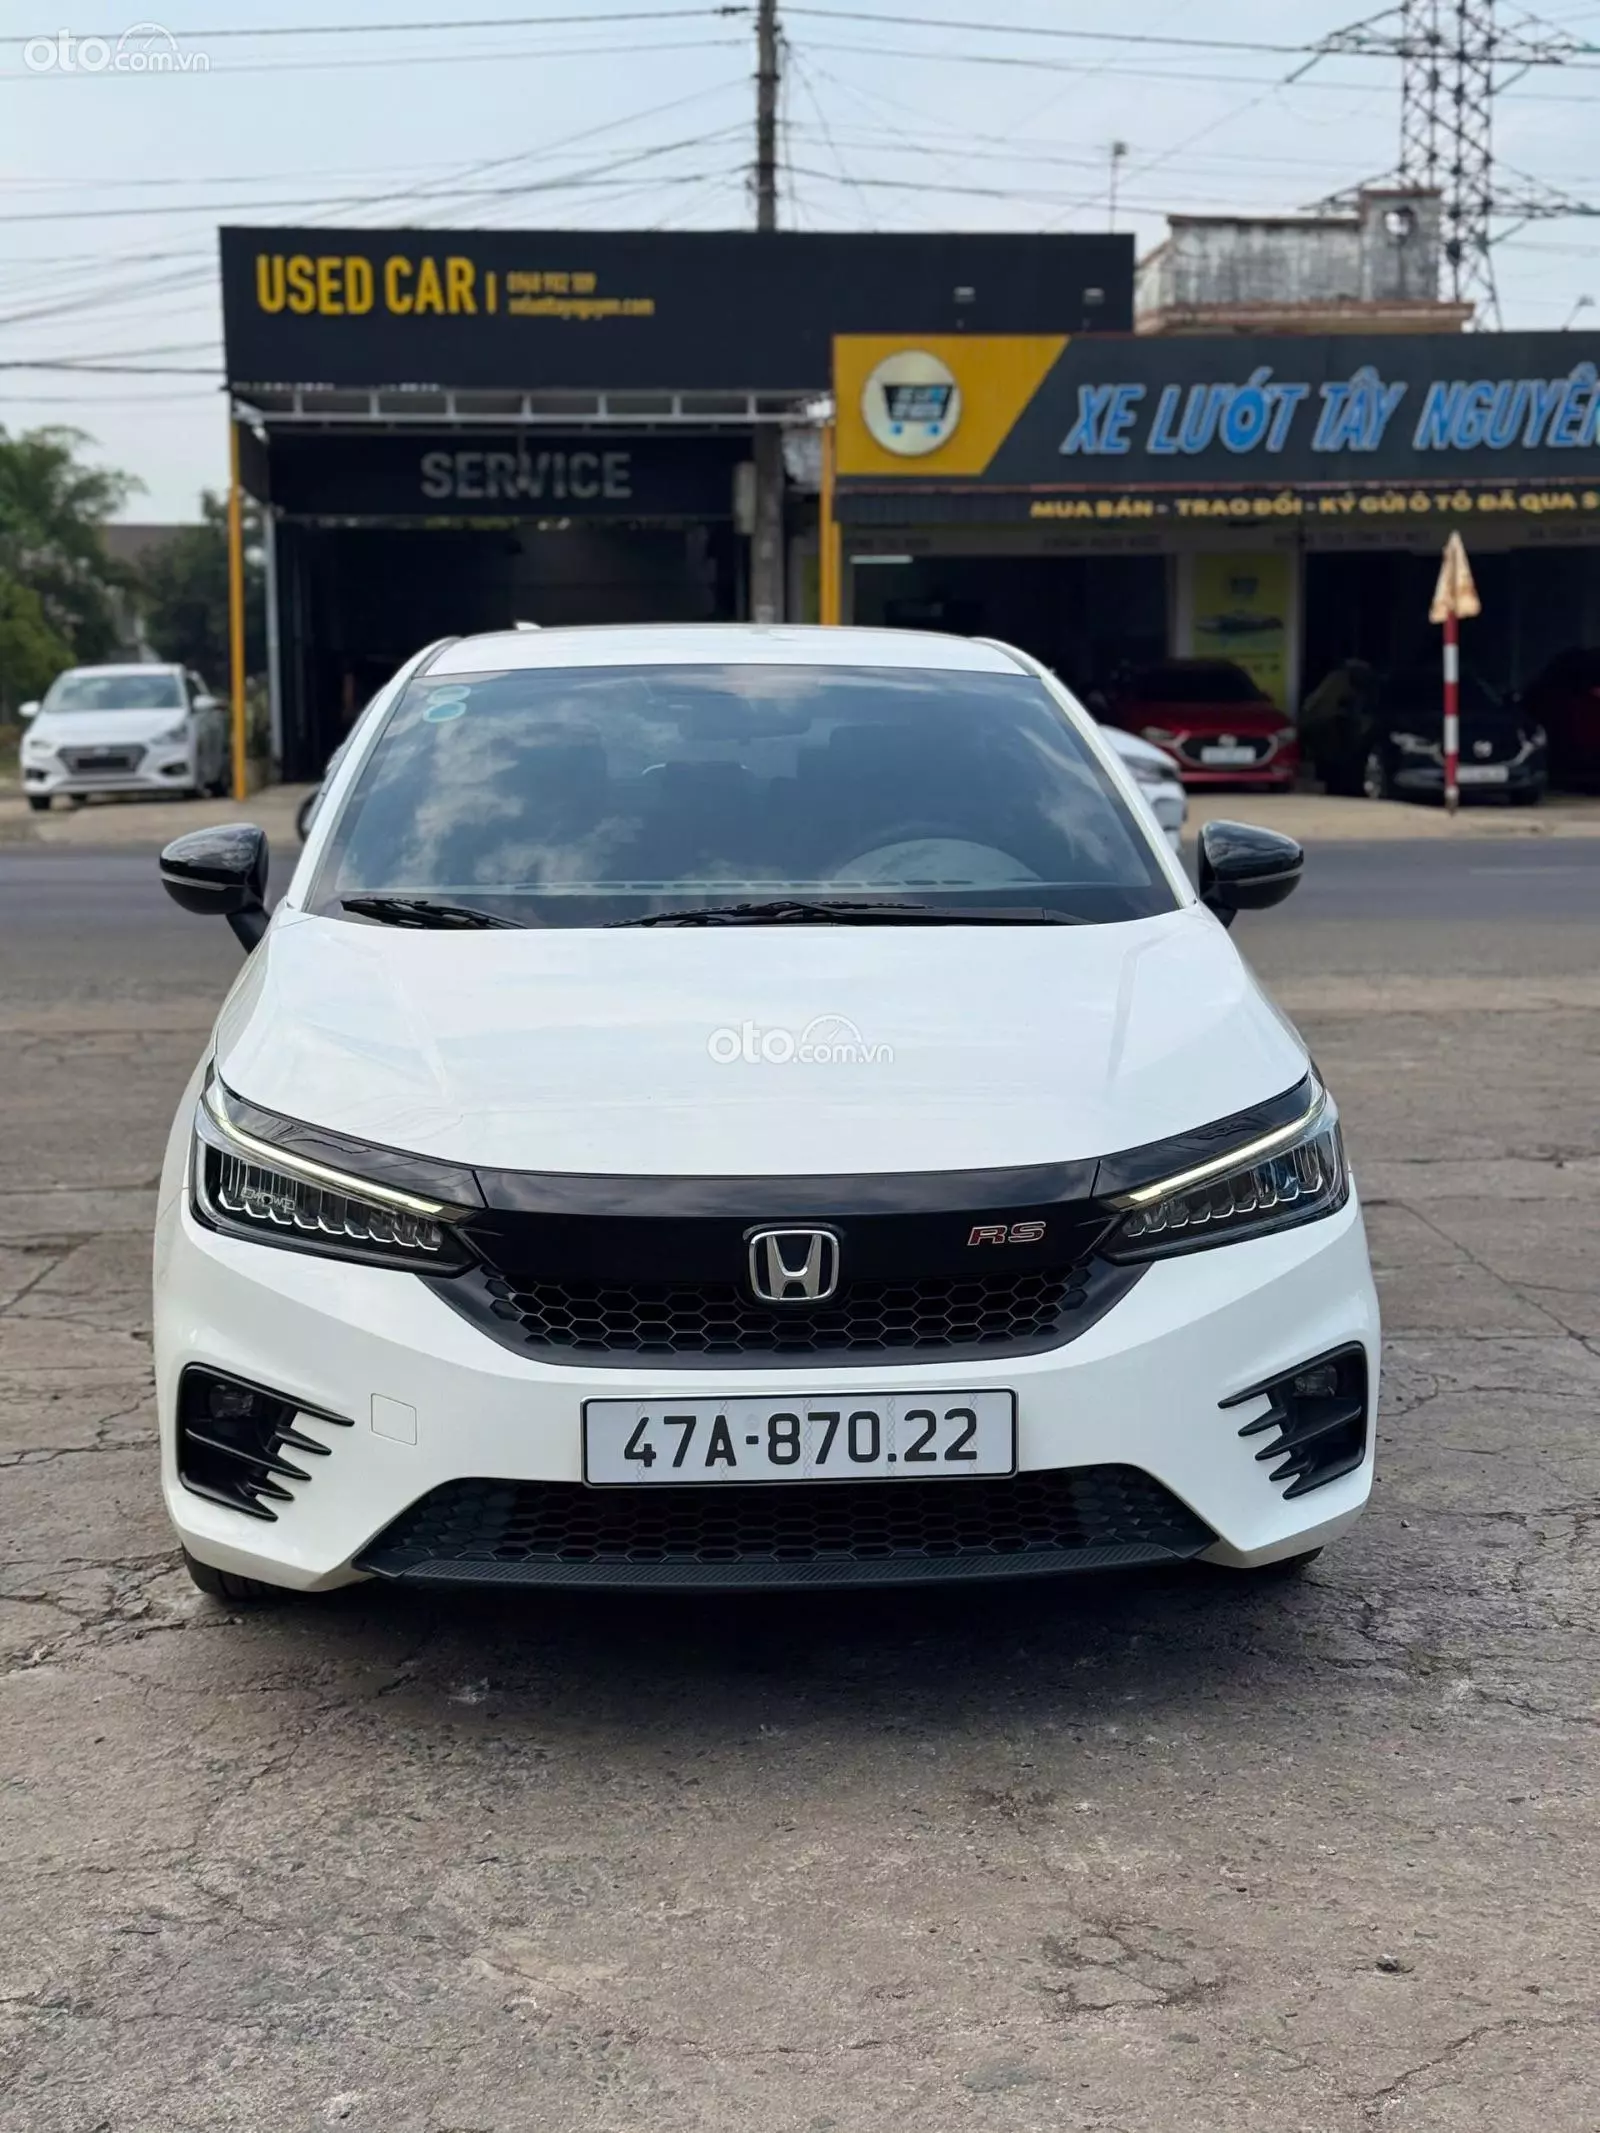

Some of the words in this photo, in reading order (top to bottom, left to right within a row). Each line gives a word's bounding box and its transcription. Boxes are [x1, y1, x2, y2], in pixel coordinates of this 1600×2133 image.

[257, 254, 374, 314] USED
[384, 255, 478, 314] CAR
[1059, 383, 1147, 454] XE
[1146, 366, 1311, 454] LƯỚT
[1311, 365, 1408, 452] TÂY
[420, 452, 633, 500] SERVICE
[1031, 500, 1092, 517] MUA
[1096, 495, 1153, 517] BÁN
[1175, 497, 1250, 516] TRAO
[1434, 488, 1473, 512] TÔ
[1519, 493, 1576, 514] QUA
[966, 1221, 1046, 1246] RS
[623, 1407, 978, 1468] 47A-870.22
